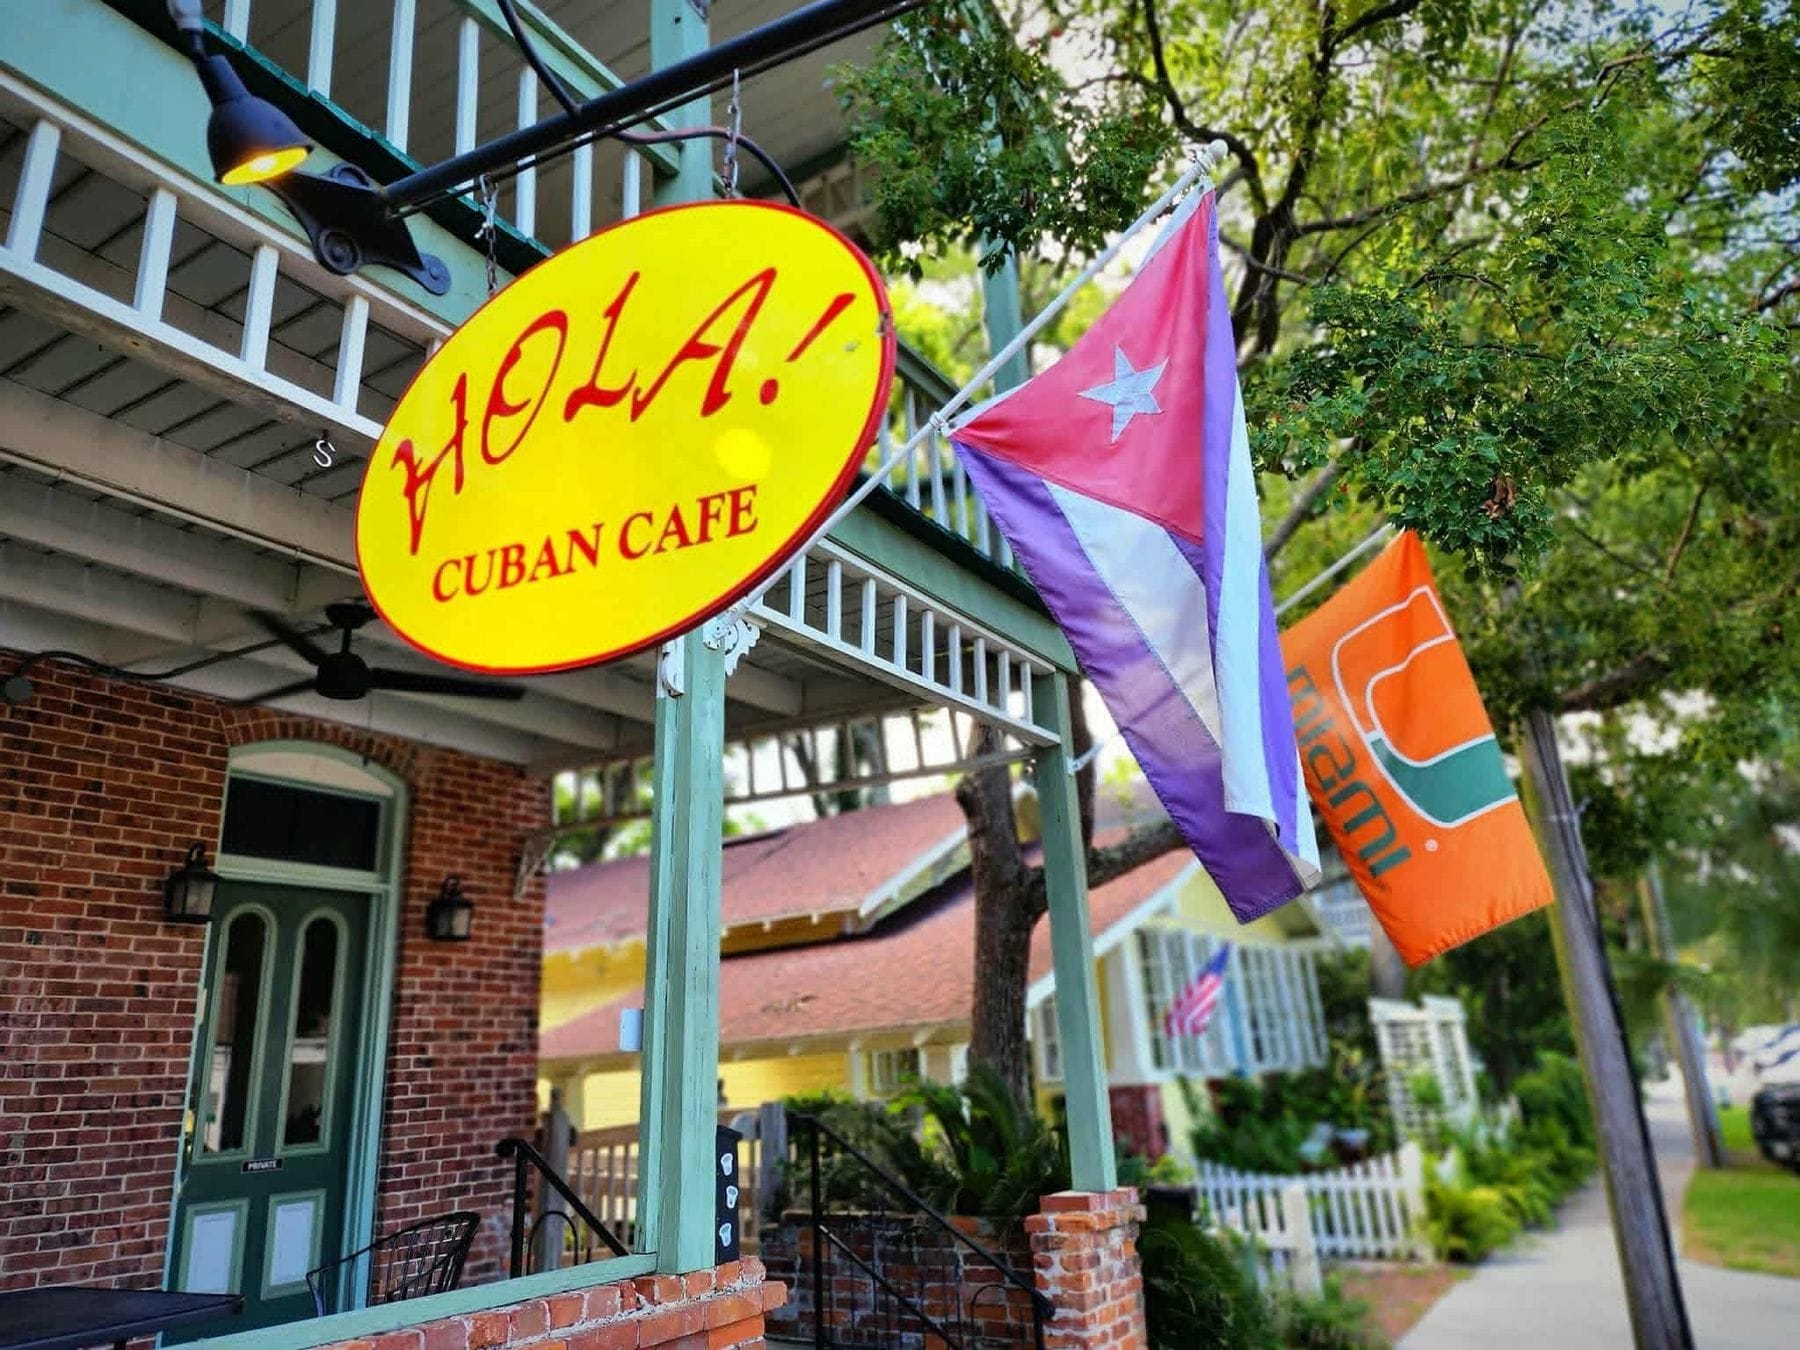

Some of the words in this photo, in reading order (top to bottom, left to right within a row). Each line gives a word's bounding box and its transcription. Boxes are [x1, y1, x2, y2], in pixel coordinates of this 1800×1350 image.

[391, 267, 856, 555] HOLA!
[432, 523, 603, 603] CUBAN
[617, 485, 759, 561] CAFE
[247, 1160, 277, 1170] PRIVATE
